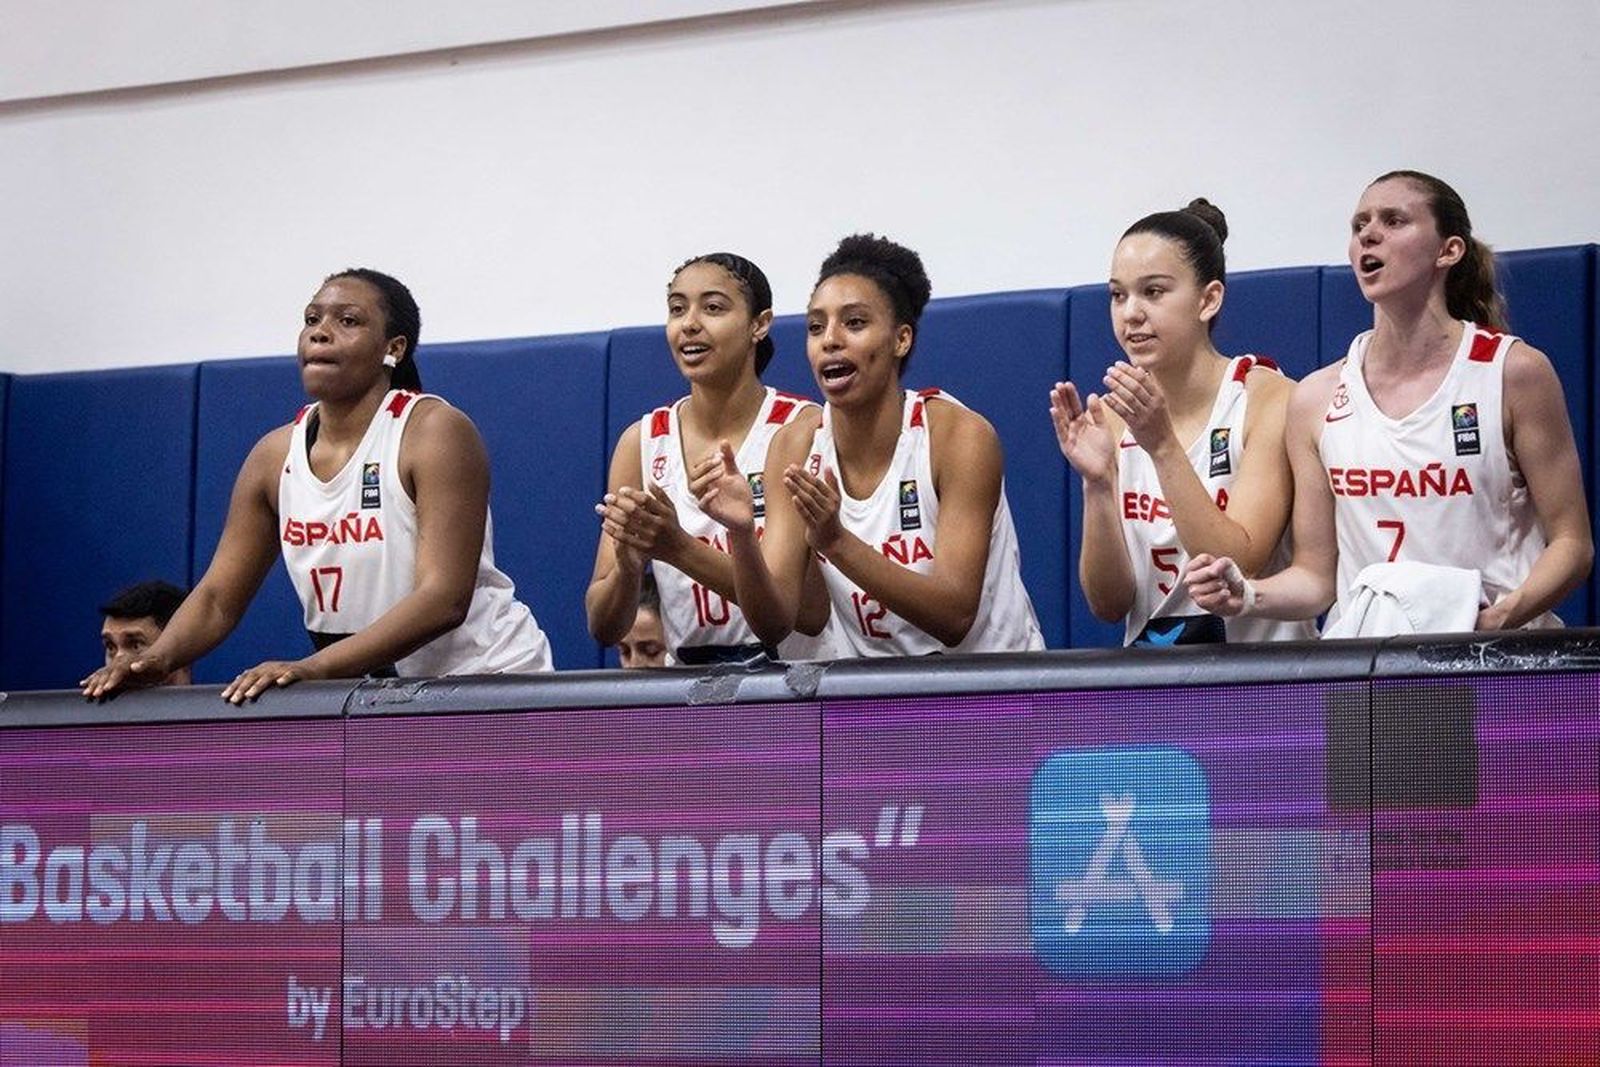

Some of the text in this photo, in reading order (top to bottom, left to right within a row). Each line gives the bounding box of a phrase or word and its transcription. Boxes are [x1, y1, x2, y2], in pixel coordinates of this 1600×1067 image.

[1328, 462, 1473, 497] ESPAÑA
[1123, 488, 1229, 524] ESPA
[1376, 520, 1405, 563] 7
[310, 567, 343, 613] 17
[1150, 547, 1179, 596] 5
[691, 582, 730, 627] 10
[851, 591, 892, 639] 12
[0, 817, 383, 924] Basketball
[286, 974, 525, 1042] by EuroStep
